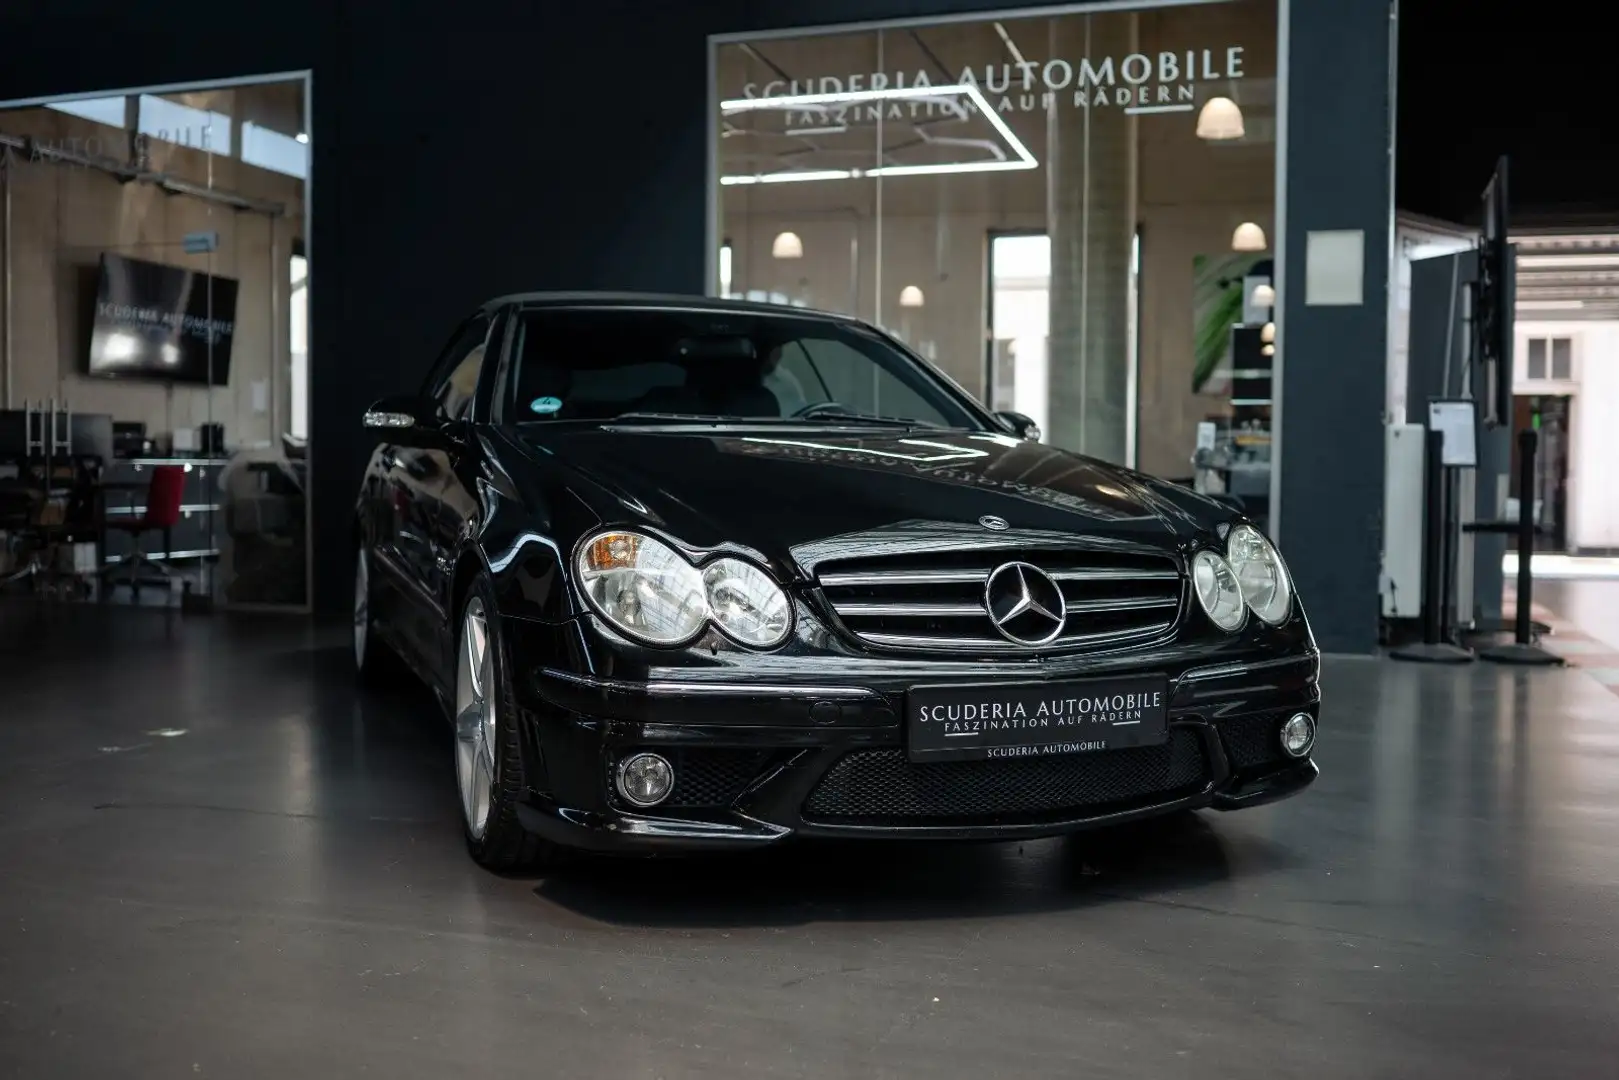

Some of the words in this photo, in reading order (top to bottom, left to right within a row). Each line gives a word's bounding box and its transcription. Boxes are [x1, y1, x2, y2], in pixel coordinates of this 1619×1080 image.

[743, 69, 931, 103] SCUDERIA
[957, 46, 1244, 94] AUTOMOBILE
[998, 93, 1056, 112] AUF
[1074, 83, 1195, 108] RÄDERN
[920, 702, 1027, 722] SCUDERIA
[1037, 692, 1161, 716] AUTOMOBILE
[944, 718, 1049, 732] FASZINATION
[1058, 715, 1083, 726] AUF
[1091, 710, 1142, 722] RÄDERN
[987, 746, 1039, 758] SCUDERIA
[1042, 740, 1106, 755] AUTOMOBILE
